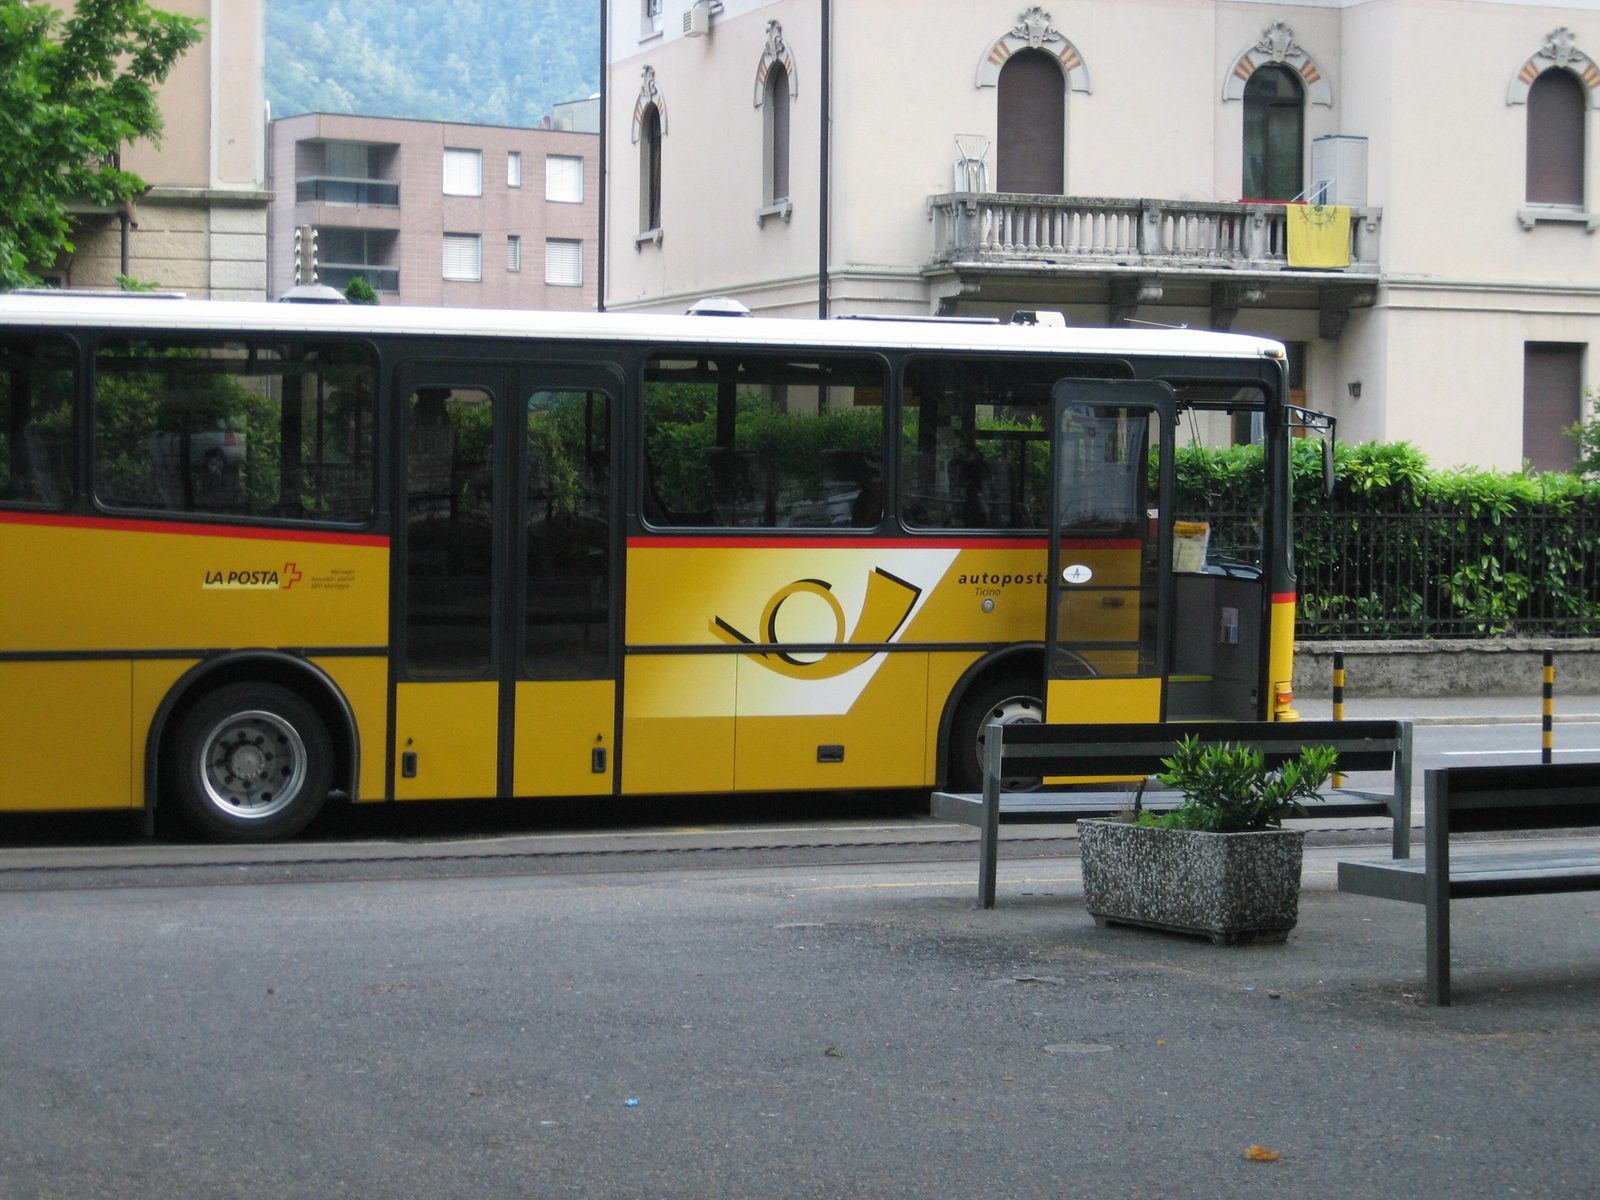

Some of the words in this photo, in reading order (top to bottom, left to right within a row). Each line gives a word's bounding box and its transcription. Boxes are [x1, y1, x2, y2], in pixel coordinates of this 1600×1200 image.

[205, 571, 223, 584] LA
[227, 571, 279, 584] POSTA
[975, 587, 1001, 596] Ticino
